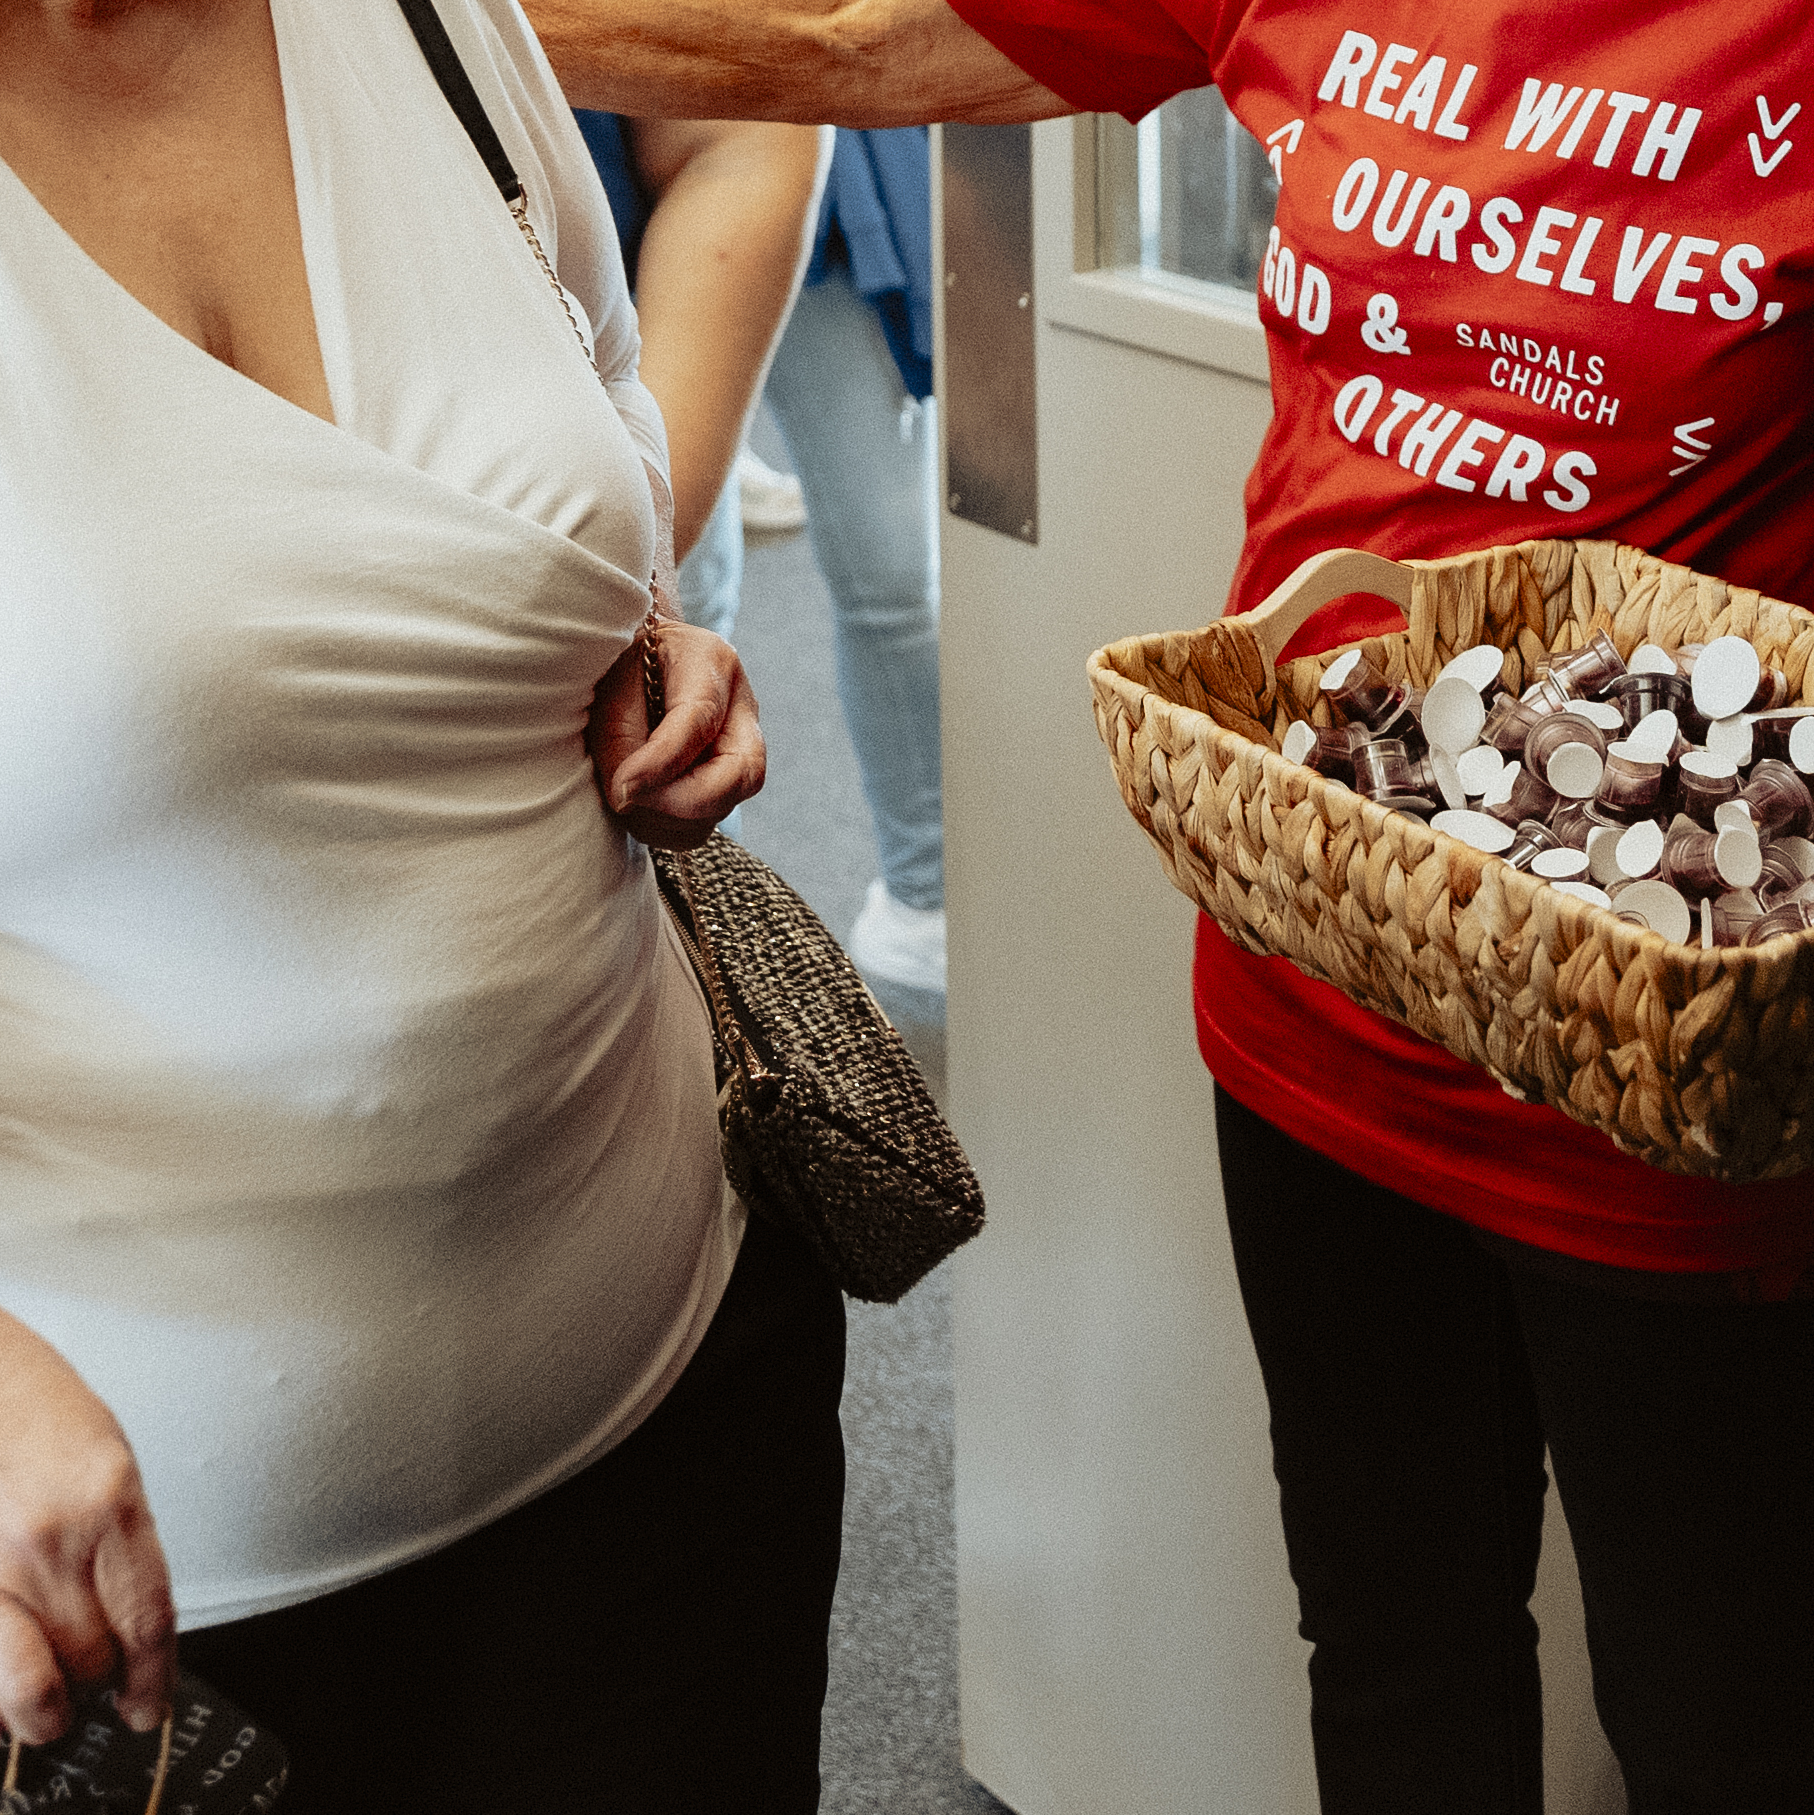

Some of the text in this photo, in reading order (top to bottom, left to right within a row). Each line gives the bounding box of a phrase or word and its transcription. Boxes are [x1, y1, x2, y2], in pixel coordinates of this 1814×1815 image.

[1317, 30, 1703, 181] REAL WITH
[1263, 225, 1412, 355] GOD &
[1331, 157, 1784, 330] OURSELVES,
[1455, 322, 1605, 386] SANDALS
[1489, 356, 1620, 426] CHURCH
[1333, 374, 1598, 512] OTHERS
